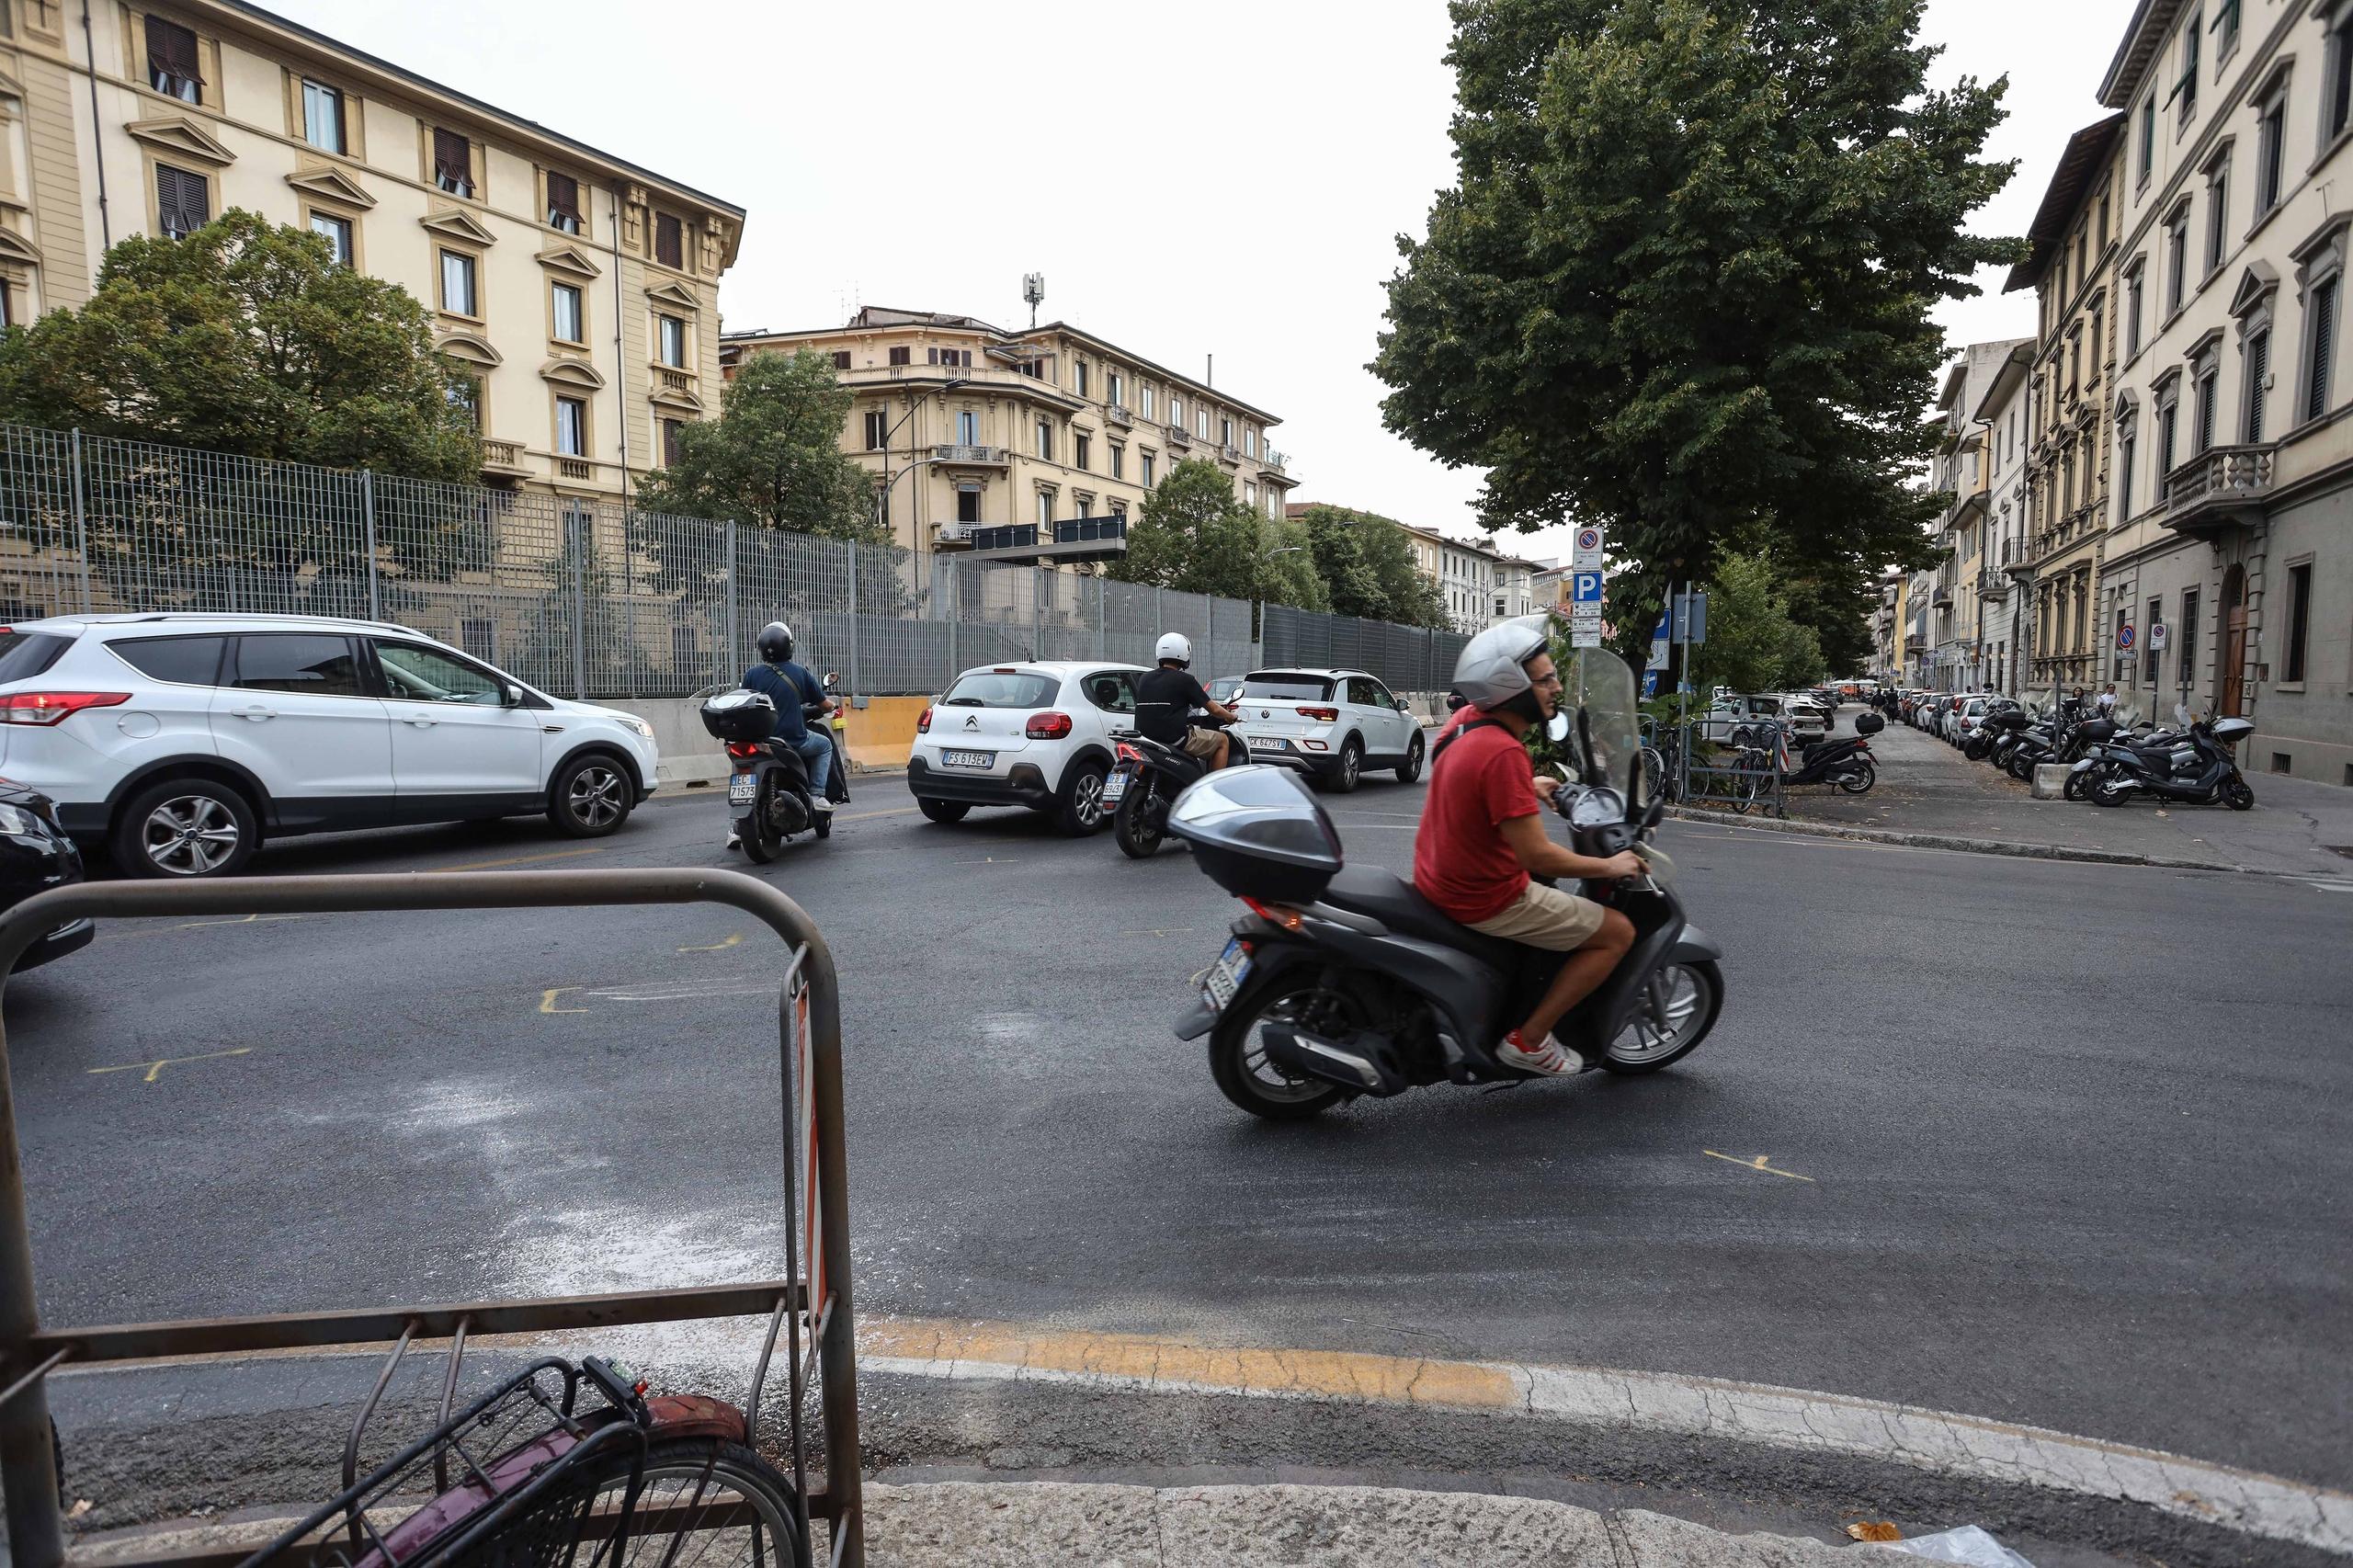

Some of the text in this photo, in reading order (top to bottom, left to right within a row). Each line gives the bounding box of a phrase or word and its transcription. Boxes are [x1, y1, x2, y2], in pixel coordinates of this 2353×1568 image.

[1578, 575, 1597, 599] P
[949, 753, 988, 766] FS 613EW
[737, 775, 747, 785] EC
[1112, 775, 1120, 783] FB
[731, 787, 755, 797] 71573
